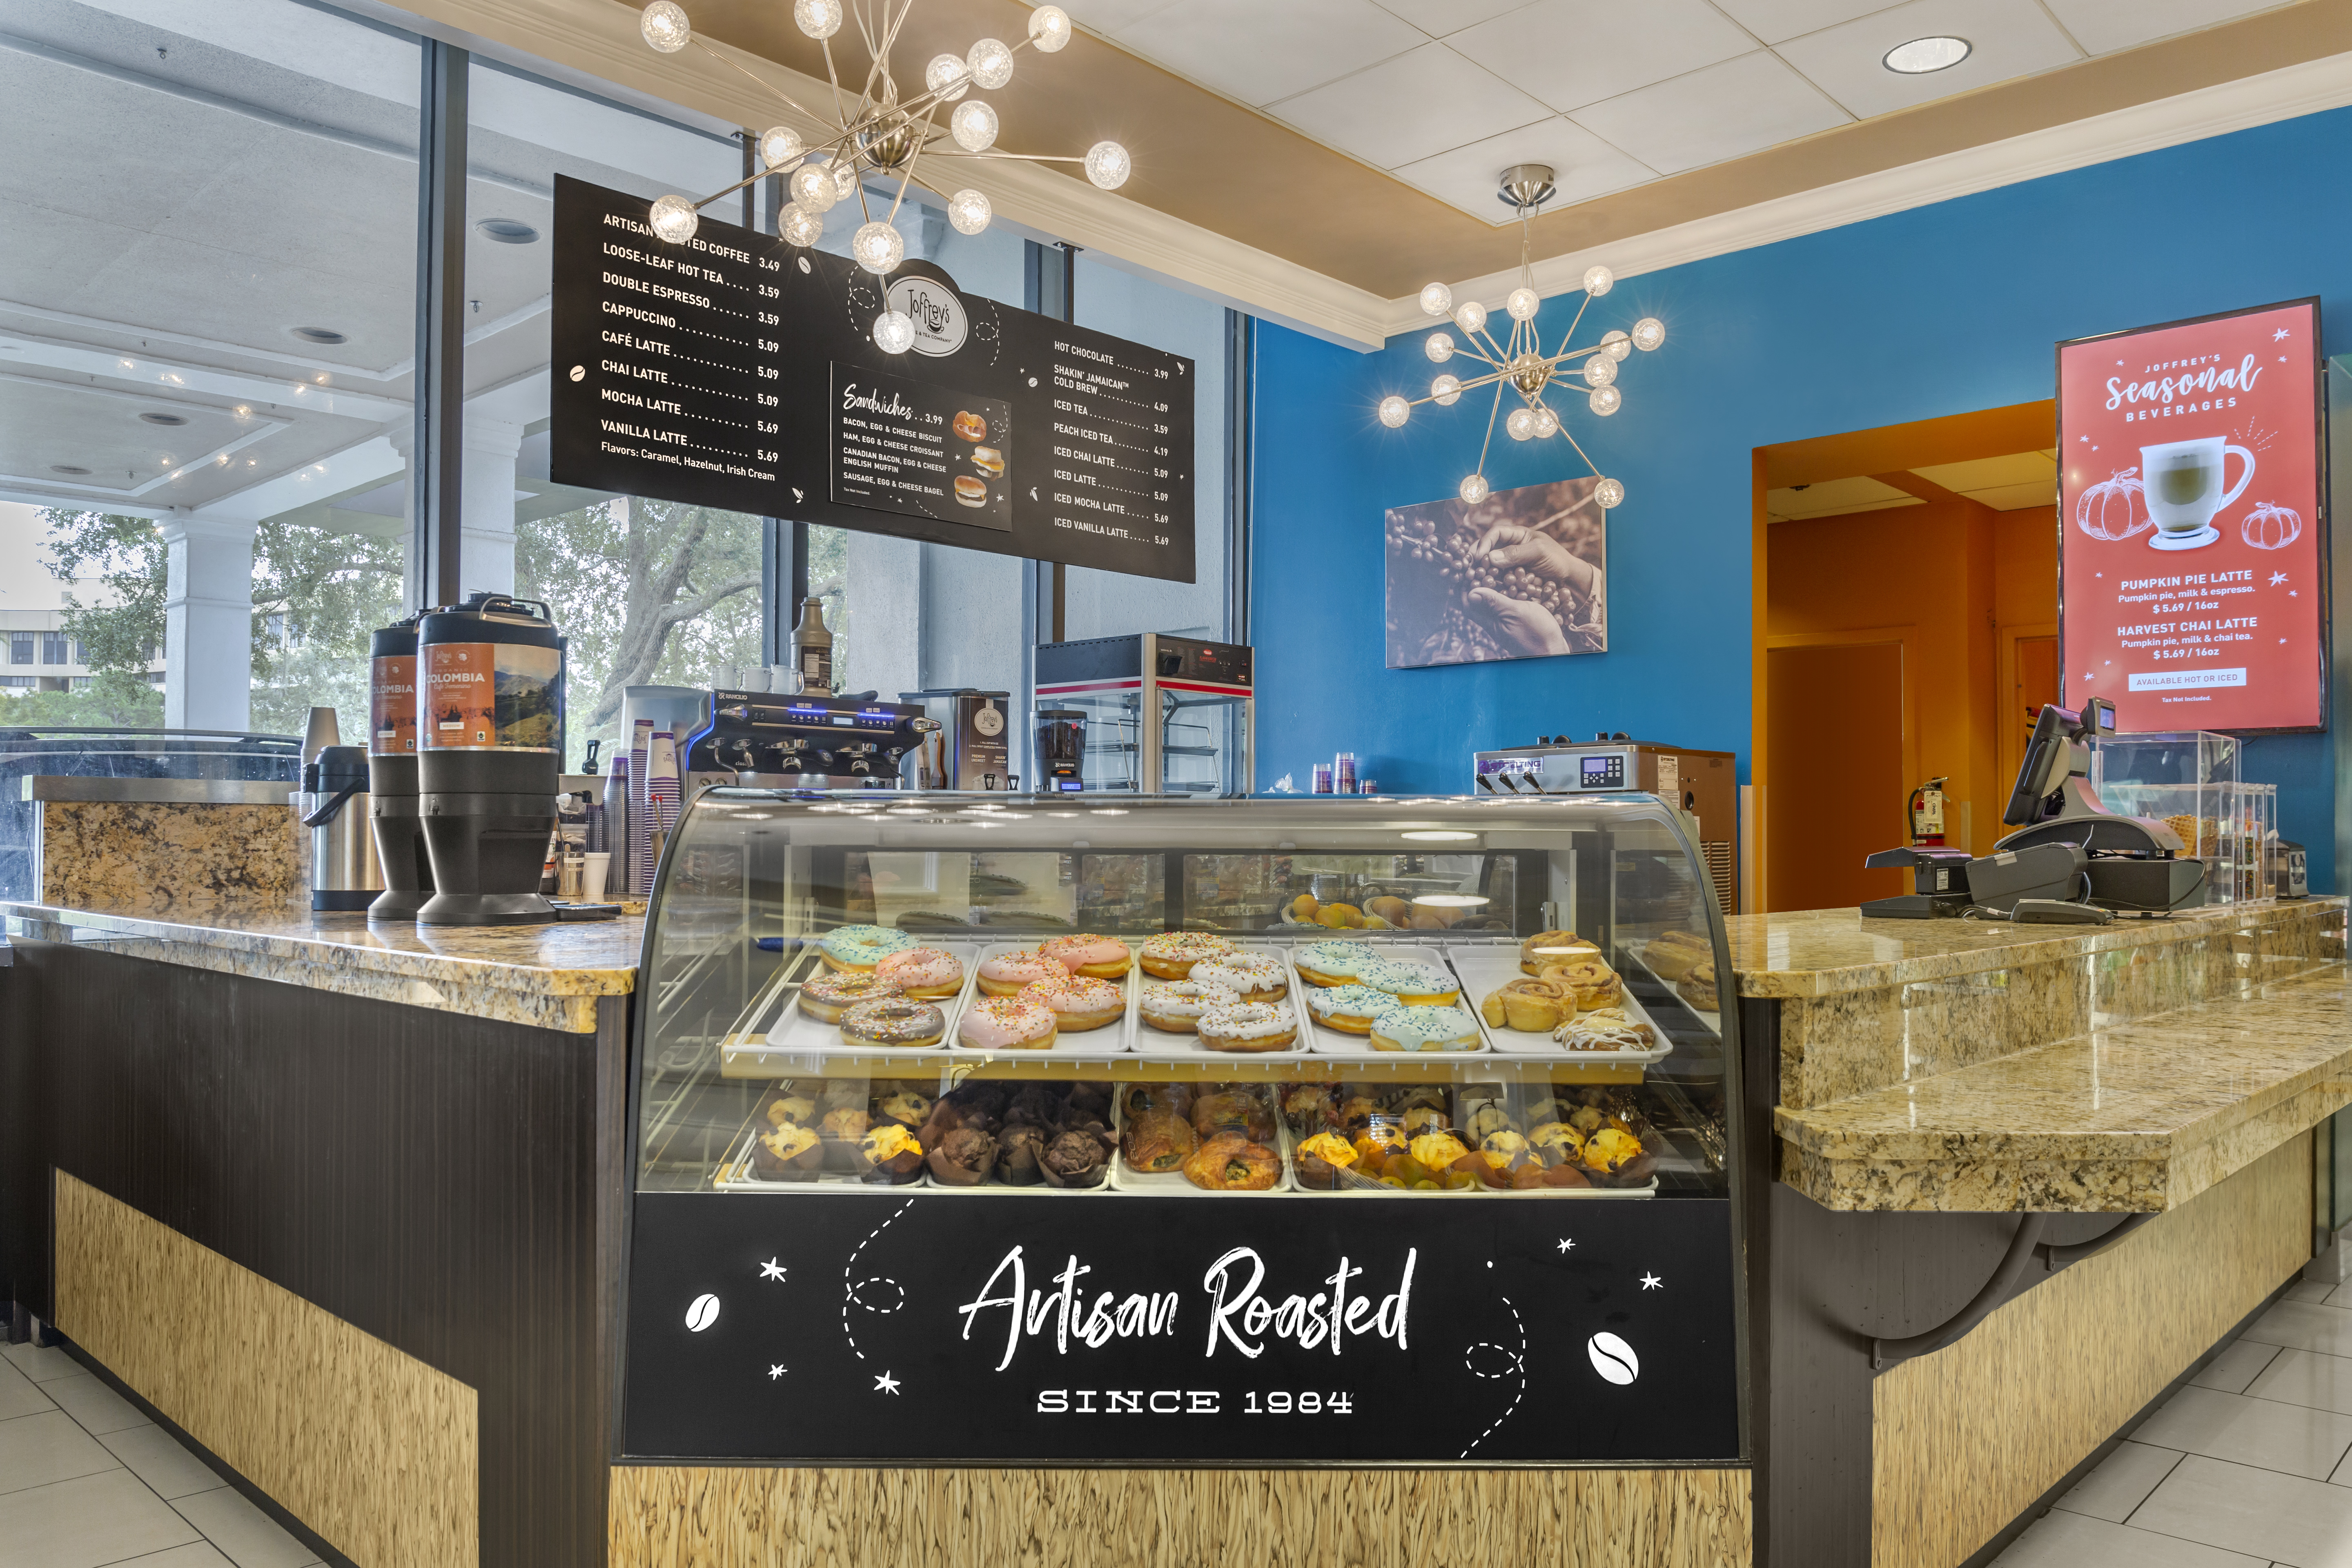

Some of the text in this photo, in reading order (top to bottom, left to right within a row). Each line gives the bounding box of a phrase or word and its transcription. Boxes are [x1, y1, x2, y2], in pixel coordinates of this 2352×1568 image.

[604, 214, 653, 237] ARTISAN
[709, 244, 749, 263] COFFEE
[760, 258, 780, 271] 3.49
[604, 243, 674, 270] LOOSE-LEAF
[678, 263, 699, 277] HOT
[703, 269, 723, 284] TEA
[759, 285, 779, 298] 3.59
[604, 272, 779, 325] DOUBLE ESPRESSO 3.59
[906, 290, 949, 326] Joffrey's
[603, 301, 778, 352] CAPPUCCINO 5.09
[602, 331, 778, 379] CAFÉ LATTE 5.09
[1055, 341, 1168, 379] HOT CHOCOLATE 3.99
[2145, 354, 2220, 373] JOFFREY'S
[602, 360, 778, 406] CHAI LATTE 5.09
[1054, 365, 1084, 379] SHAKIN'
[2106, 354, 2263, 410] Seasonal
[844, 384, 942, 425] Sandwiches 3.99
[1055, 376, 1168, 412] COLD BREW 4.09
[602, 389, 778, 433] MOCHA LATTE 5.69
[1055, 399, 1167, 434] ICED TEA 3.59
[2127, 397, 2236, 422] BEVERAGES
[601, 419, 778, 462] VANILLA LATTE 5.69
[844, 417, 867, 430] BACON,
[871, 423, 882, 431] EGG
[893, 428, 916, 438] CHEESE
[919, 433, 942, 443] BISCUIT
[844, 432, 860, 443] HAM,
[862, 436, 875, 444] EGG
[884, 440, 908, 450] CHEESE
[910, 445, 943, 457] CROISSANT
[1055, 423, 1167, 456] PEACH ICED TEA 4.19
[602, 442, 775, 481] Flavors: Caramel, Hazelnut, Irish Cream
[844, 447, 876, 459] CANADIAN
[879, 454, 902, 465] BACON,
[923, 463, 946, 472] CHEESE
[844, 457, 898, 473] ENGLISH MUFFIN
[1055, 446, 1167, 478] ICED CHAI LATTE 5.09
[844, 472, 875, 484] SAUSAGE,
[899, 482, 922, 492] CHEESE
[924, 487, 943, 495] BAGEL
[1055, 469, 1168, 501] ICED LATTE 5.09
[1055, 493, 1168, 523] ICED MOCHA LATTE 5.69
[1055, 517, 1168, 545] ICED VANILLA LATTE 5.69
[2118, 592, 2157, 603] Pumpkin
[2160, 591, 2176, 601] pie,
[2178, 589, 2198, 598] milk
[2210, 586, 2255, 596] espresso.
[2121, 570, 2252, 590] PUMPKIN PIE LATTE
[2153, 601, 2219, 614] $ 5.69 / 16oz
[2118, 617, 2257, 636] HARVEST CHAI LATTE
[2122, 638, 2160, 648] Pumpkin
[2163, 637, 2179, 647] pie,
[2182, 635, 2202, 644] milk
[2214, 633, 2233, 641] chai
[2153, 648, 2219, 660] $ 5.69 / 16oz
[373, 685, 414, 694] OLOMBIA
[426, 673, 485, 683] COLOMBIA
[2137, 677, 2182, 686] AVAILABLE
[959, 1245, 1417, 1371] Artisan Roasted
[1037, 1389, 1352, 1414] SINCE 1984
